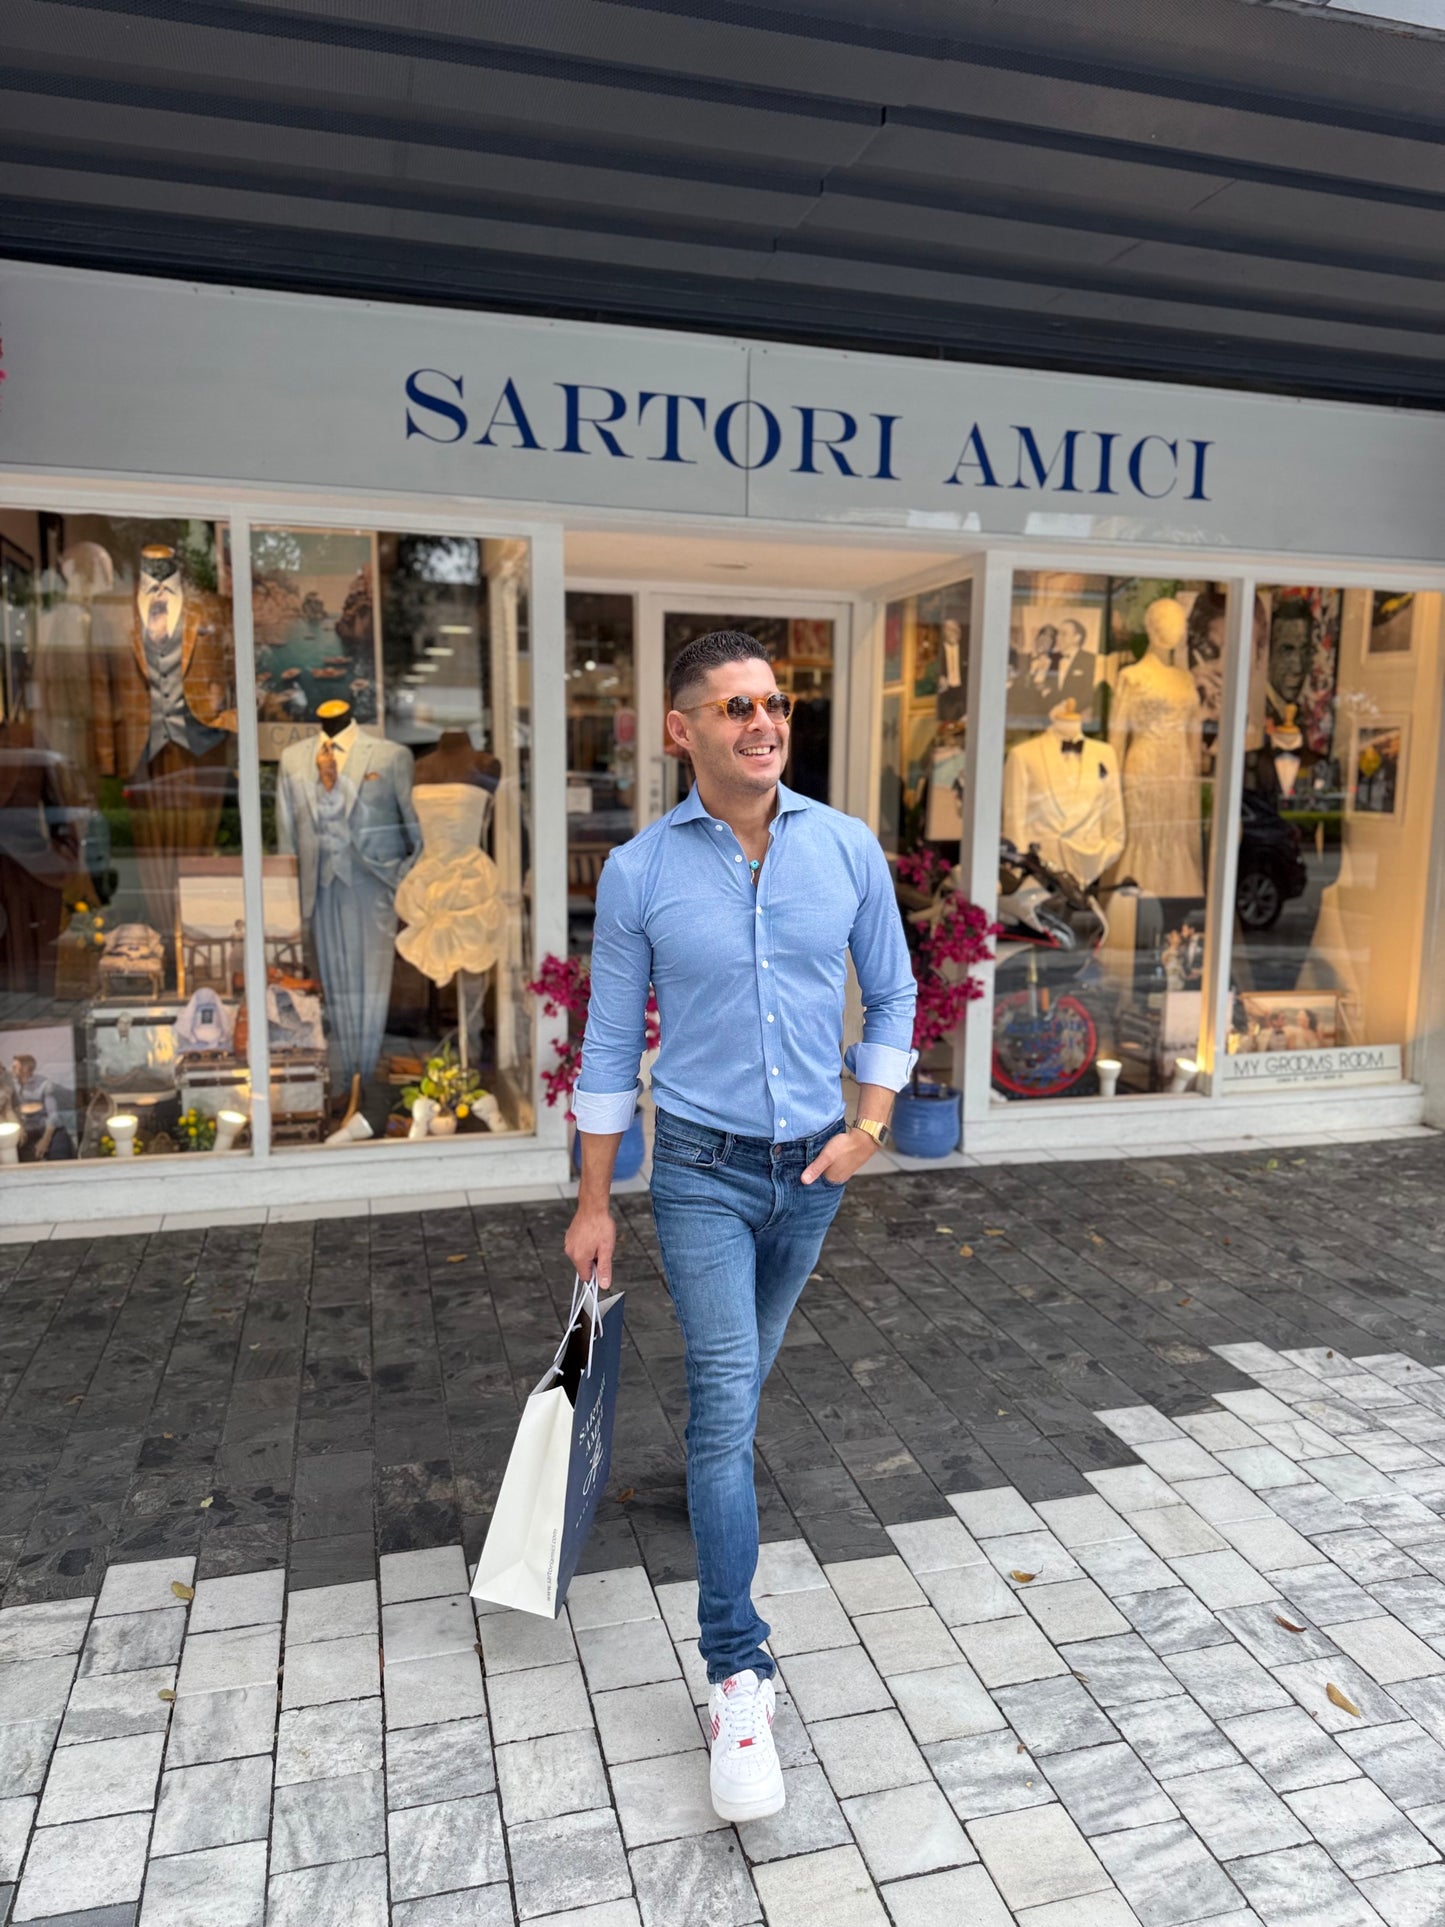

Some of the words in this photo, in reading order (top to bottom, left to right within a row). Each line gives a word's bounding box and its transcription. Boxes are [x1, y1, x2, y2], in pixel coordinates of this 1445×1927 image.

[405, 368, 902, 481] SARTORI
[943, 422, 1216, 501] AMICI
[1233, 1058, 1260, 1076] MY
[1264, 1054, 1332, 1074] GROOMS
[1338, 1050, 1383, 1069] ROOM
